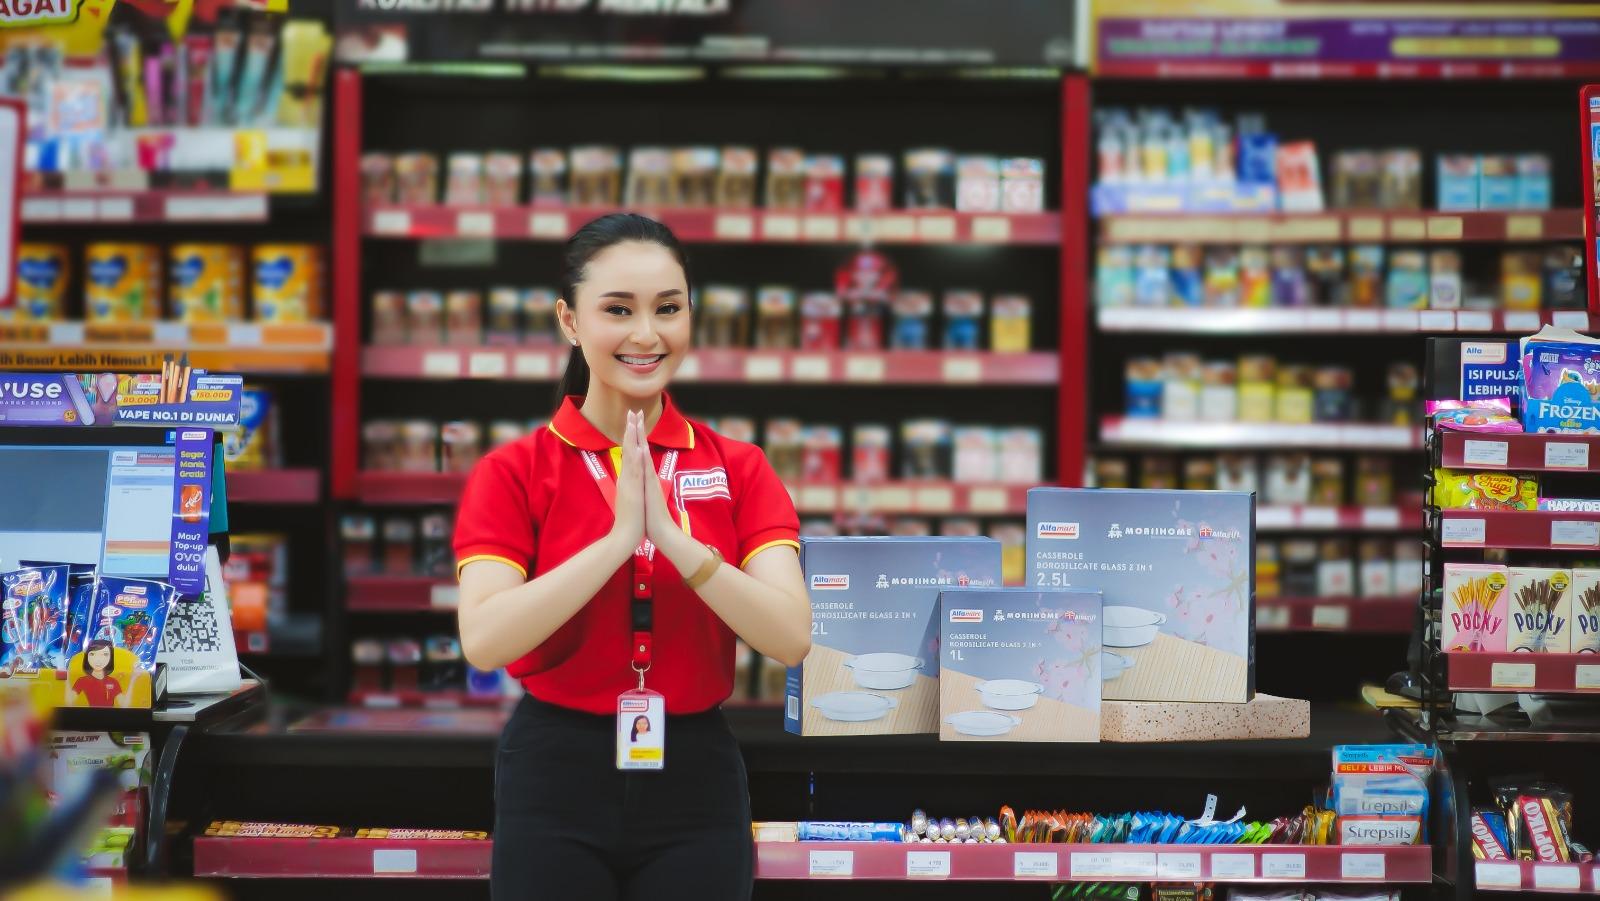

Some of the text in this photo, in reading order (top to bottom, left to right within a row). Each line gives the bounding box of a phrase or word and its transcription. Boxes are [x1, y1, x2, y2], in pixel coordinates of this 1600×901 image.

[1468, 370, 1483, 380] ISI
[1468, 385, 1502, 395] LEBIH
[119, 409, 235, 422] VAPE NO.1 DI DUNIA
[1479, 474, 1514, 484] Chupa
[1479, 480, 1512, 492] Chups
[1040, 524, 1076, 532] Alfamart
[1125, 527, 1192, 536] MORIIHOME
[177, 532, 201, 541] Mau?
[174, 541, 204, 551] Top-up
[1036, 552, 1084, 560] CASSEROLE
[1036, 562, 1098, 570] BOROSILICATE
[1100, 563, 1127, 571] GLASS
[813, 576, 847, 584] Alfamart
[891, 577, 952, 585] MORIIHOME
[1036, 572, 1071, 587] 2.5L
[811, 602, 854, 610] CASSEROLE
[812, 621, 828, 635] 2L
[949, 649, 964, 661] 1L
[1348, 825, 1411, 841] Strepsils
